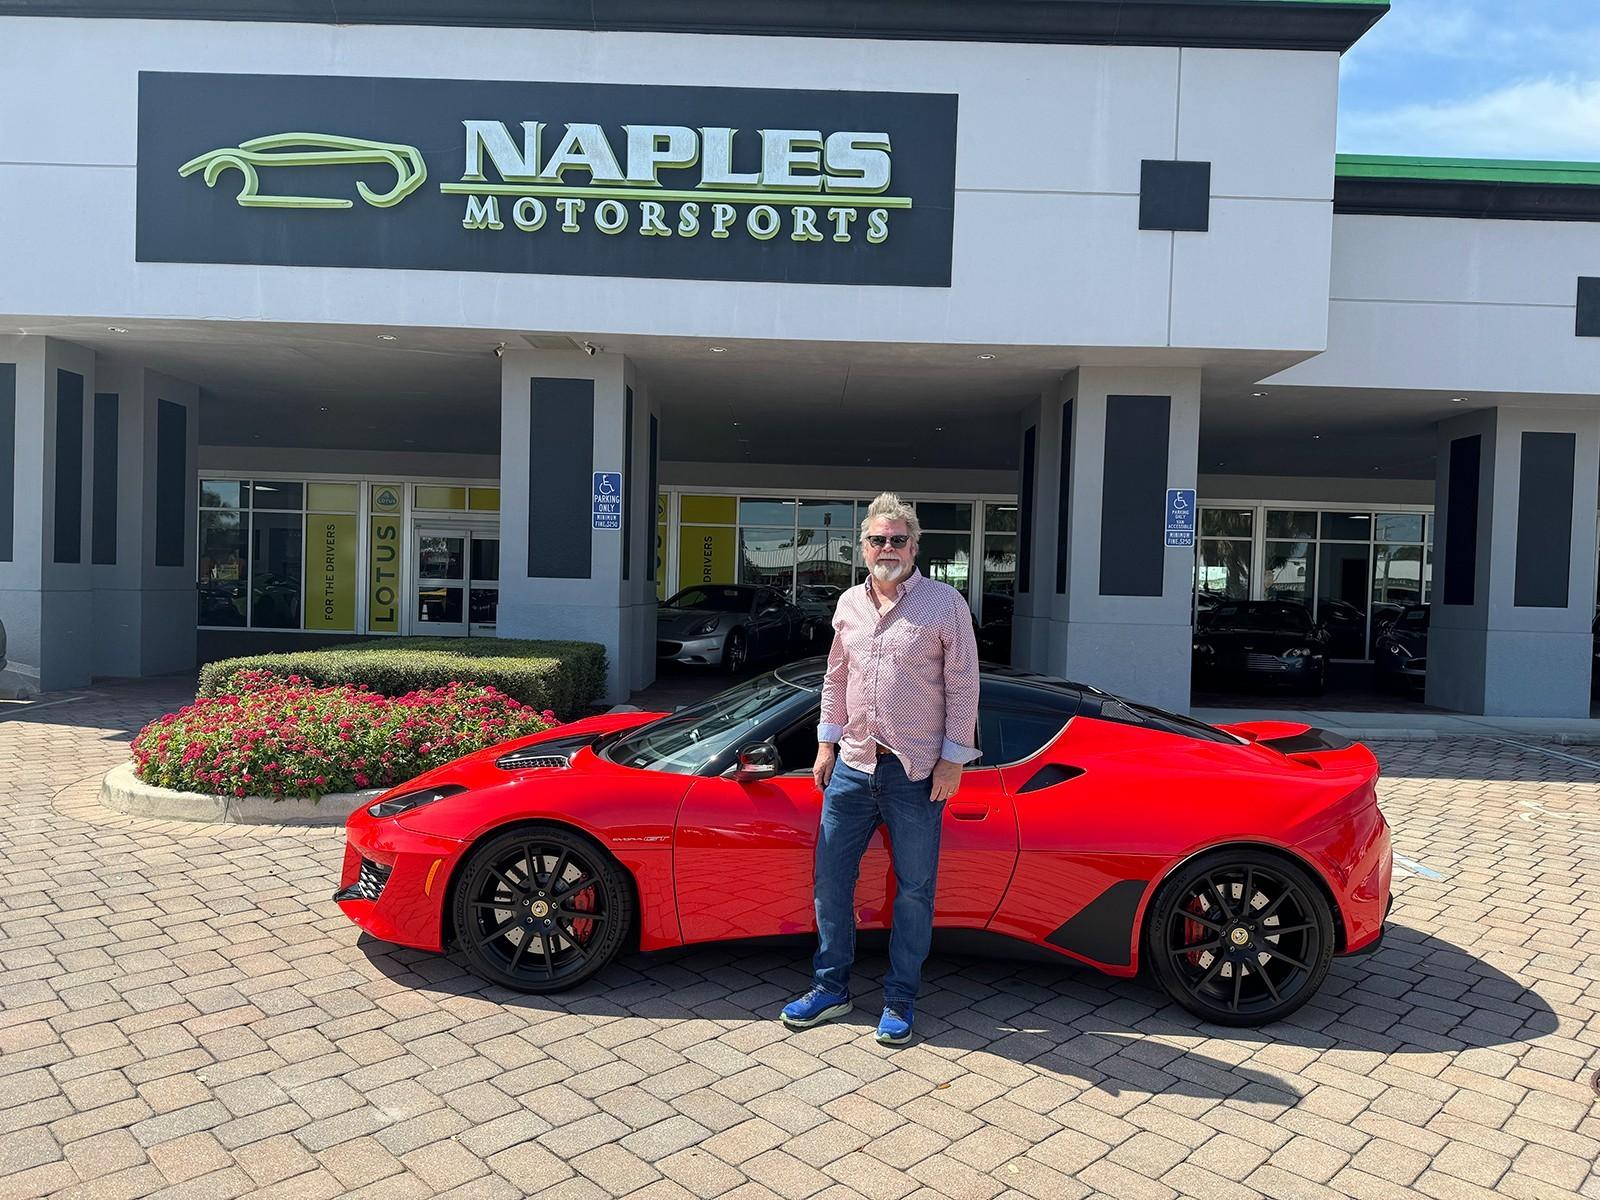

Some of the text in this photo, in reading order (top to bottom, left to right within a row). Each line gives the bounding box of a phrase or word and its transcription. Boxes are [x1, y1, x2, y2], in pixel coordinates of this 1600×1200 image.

[461, 119, 892, 193] NAPLES
[462, 195, 890, 244] MOTORSPORTS
[594, 495, 620, 503] PARKING
[599, 504, 615, 512] ONLY
[325, 524, 335, 620] FOR THE DRIVERS
[375, 525, 396, 622] LOTUS
[703, 535, 713, 583] DRIVERS
